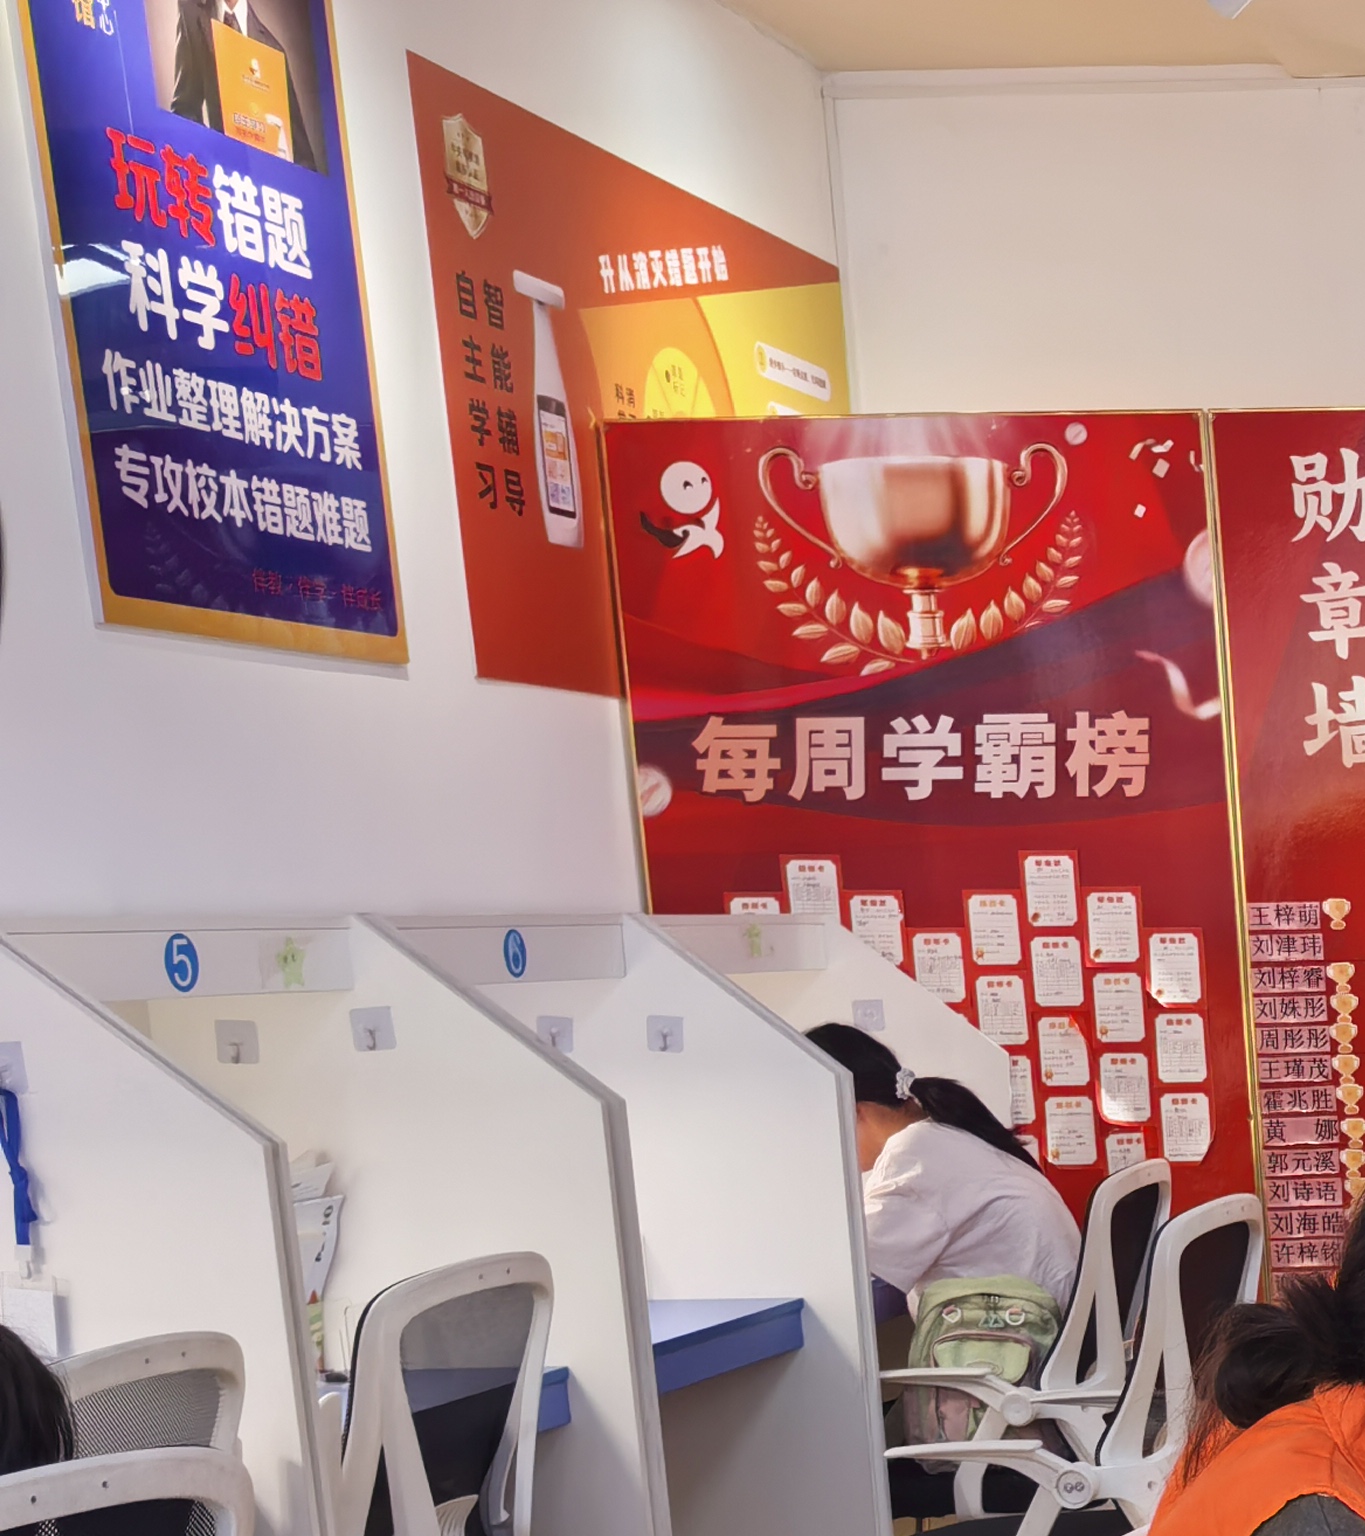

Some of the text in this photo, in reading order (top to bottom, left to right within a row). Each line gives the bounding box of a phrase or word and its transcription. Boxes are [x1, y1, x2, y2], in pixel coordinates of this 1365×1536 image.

[105, 126, 313, 281] 玩转错题
[598, 245, 729, 294] 升从消灭错题开始
[121, 238, 323, 383] 科学纠错
[102, 350, 364, 471] 作业整理解决方案
[456, 272, 499, 511] 自主学习
[482, 278, 526, 518] 智能辅导
[114, 444, 372, 553] 专攻校本错题难题
[692, 710, 1152, 802] 每周学霸榜
[1250, 904, 1320, 928] 王梓萌
[172, 938, 194, 987] 5
[508, 935, 521, 975] 6
[1253, 935, 1322, 957] 刘津玮
[1254, 967, 1324, 989] 刘梓睿
[1260, 1028, 1329, 1050] 周彤彤
[1261, 1058, 1330, 1080] 王瑾茂
[1263, 1089, 1333, 1112] 霍兆胜
[1264, 1118, 1338, 1143] 黄 娜
[1267, 1151, 1336, 1174] 郭元溪
[1269, 1181, 1338, 1202] 刘诗语
